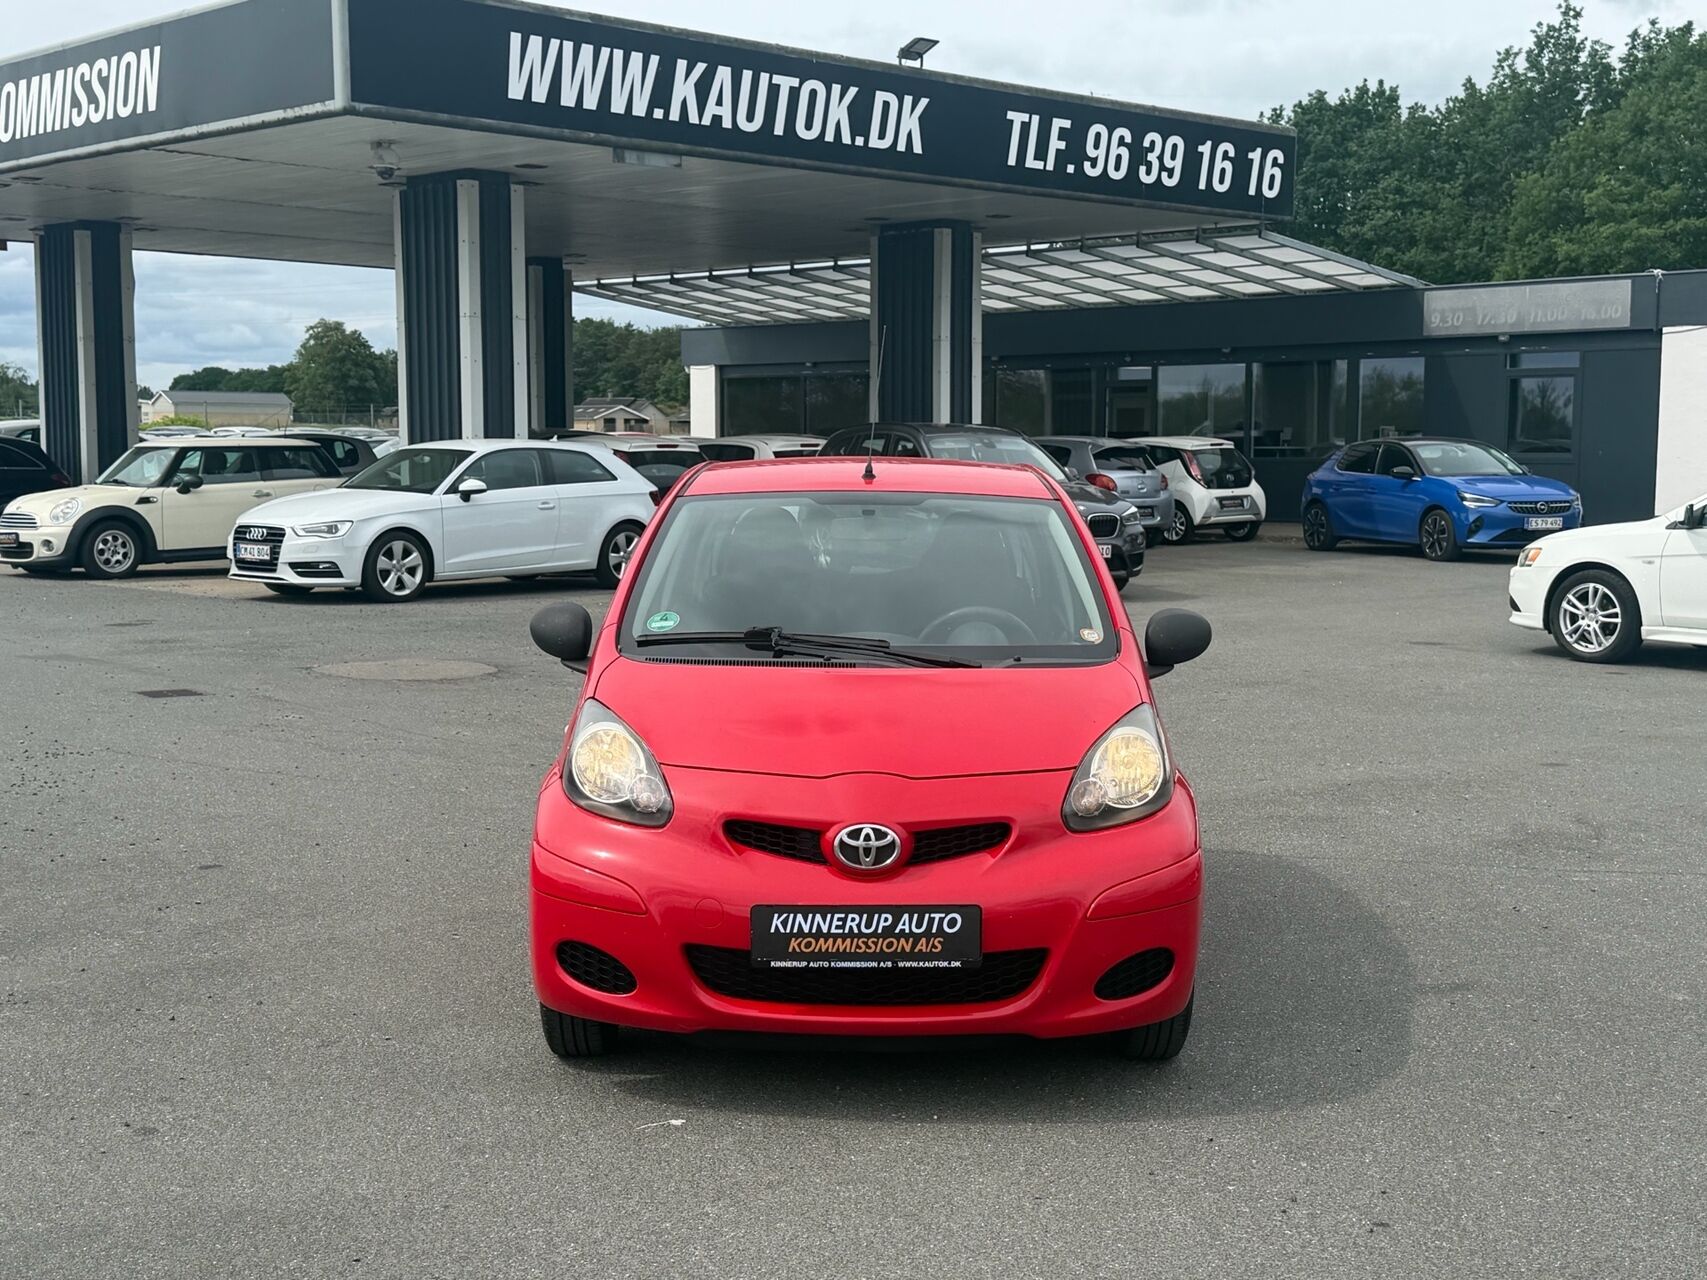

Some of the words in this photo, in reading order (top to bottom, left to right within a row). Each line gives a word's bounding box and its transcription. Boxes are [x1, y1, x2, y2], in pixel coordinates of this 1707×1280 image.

[0, 45, 161, 143] OMMISSION
[507, 31, 931, 155] WWW.KAUTOK.DK
[1006, 110, 1076, 174] TLF.
[1083, 123, 1132, 180] 96
[1138, 132, 1185, 187] 39
[1198, 140, 1235, 193] 16
[1248, 147, 1285, 198] 16
[770, 913, 893, 934] KINNERUP
[894, 912, 962, 934] AUTO
[788, 937, 914, 953] KOMMISSION
[914, 937, 944, 953] A/S
